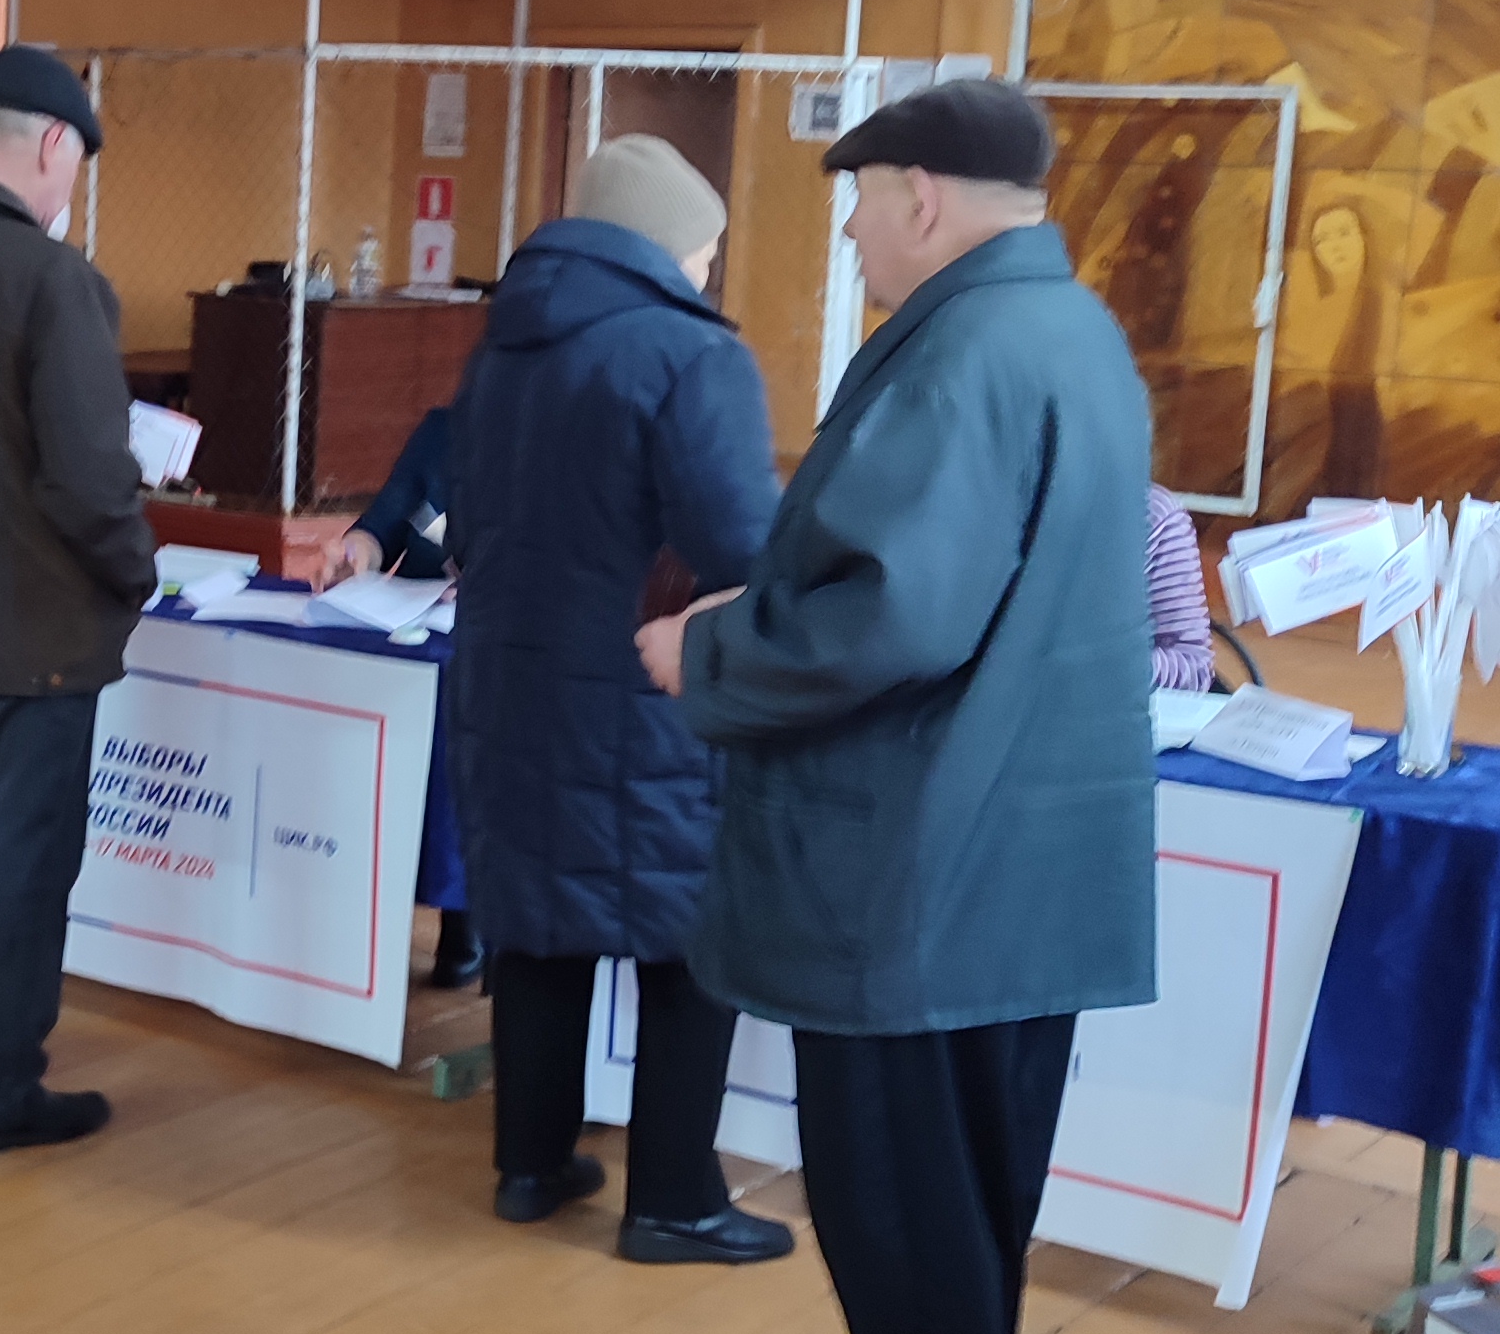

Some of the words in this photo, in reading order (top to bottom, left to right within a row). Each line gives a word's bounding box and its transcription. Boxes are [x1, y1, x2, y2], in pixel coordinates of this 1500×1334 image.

[101, 735, 209, 779] ВЫБОРЫ
[114, 839, 172, 872] МАРТА
[174, 852, 216, 881] 2024
